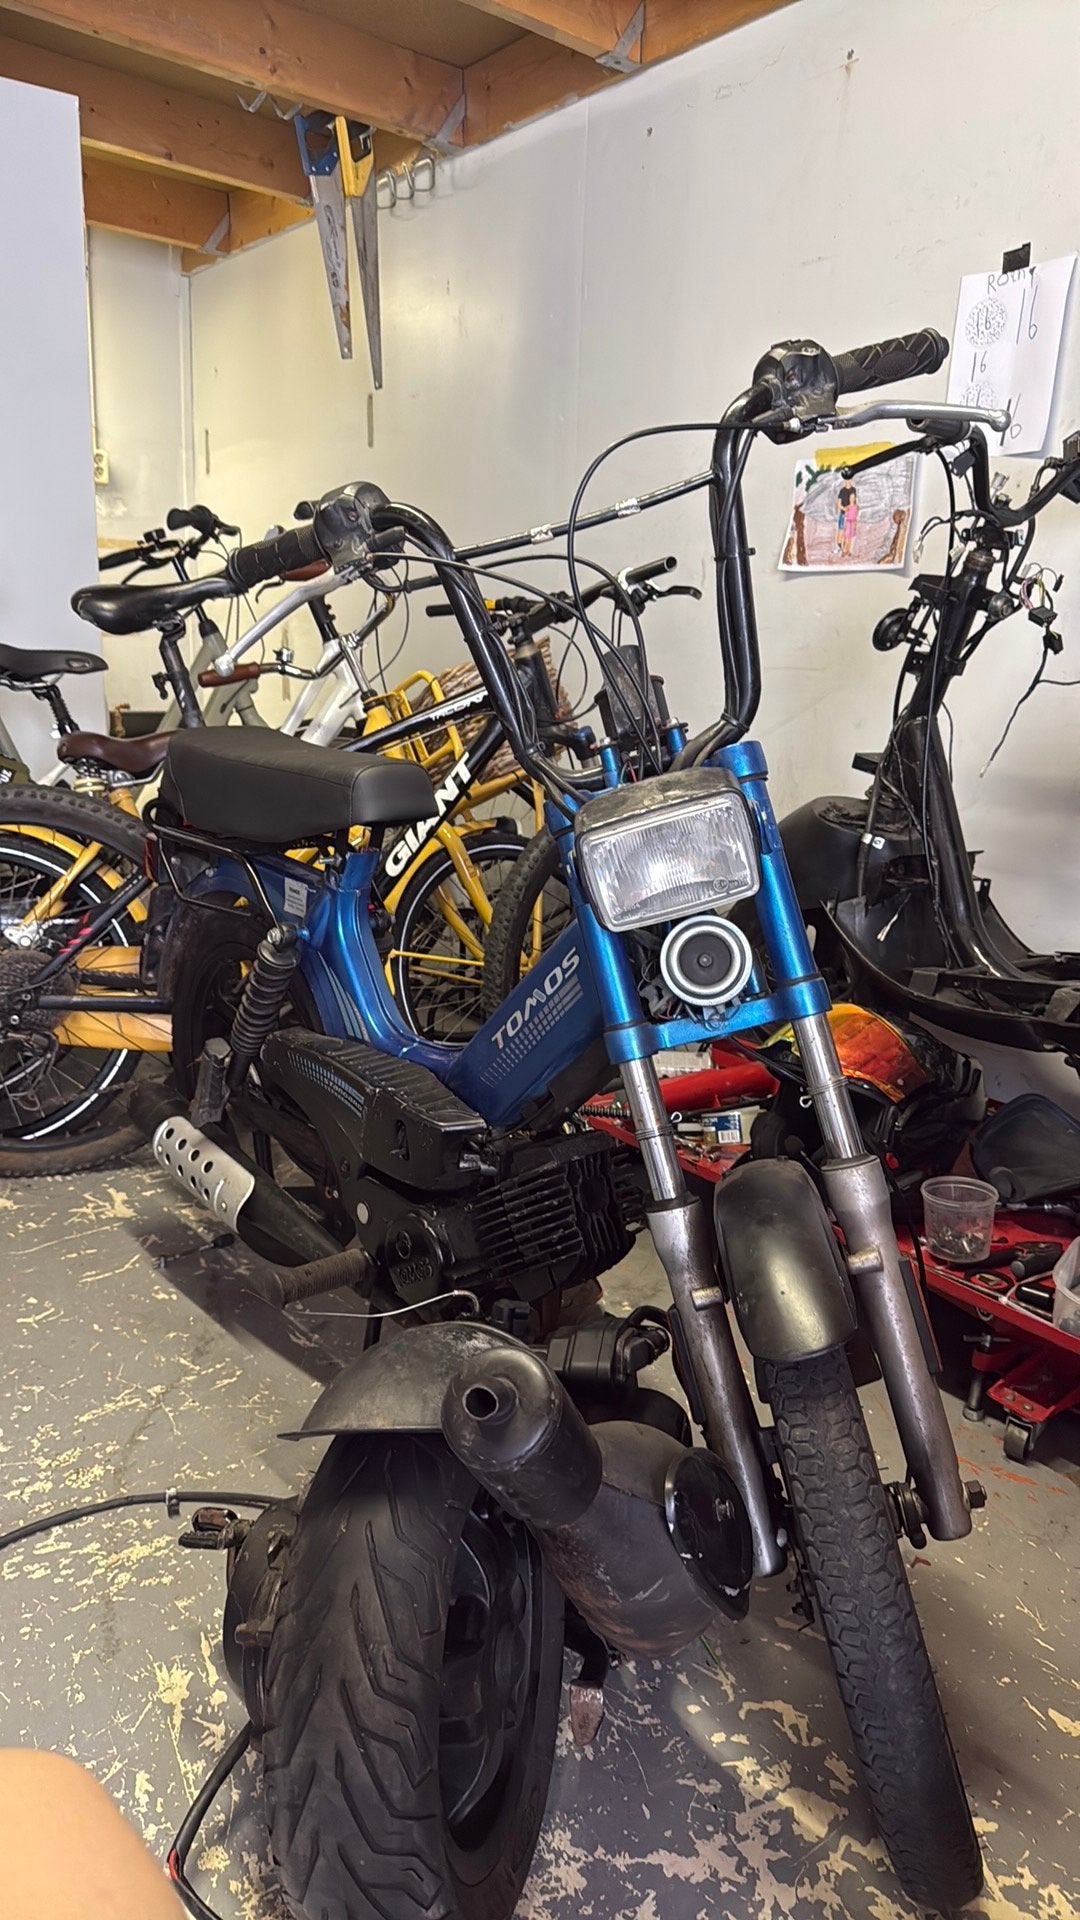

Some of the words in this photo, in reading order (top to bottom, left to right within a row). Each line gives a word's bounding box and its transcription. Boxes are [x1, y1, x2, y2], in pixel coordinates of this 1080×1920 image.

[976, 307, 991, 339] 16
[1016, 285, 1038, 345] 16
[971, 350, 987, 383] 16
[385, 752, 472, 877] GIANT
[491, 946, 580, 1050] TOMOS
